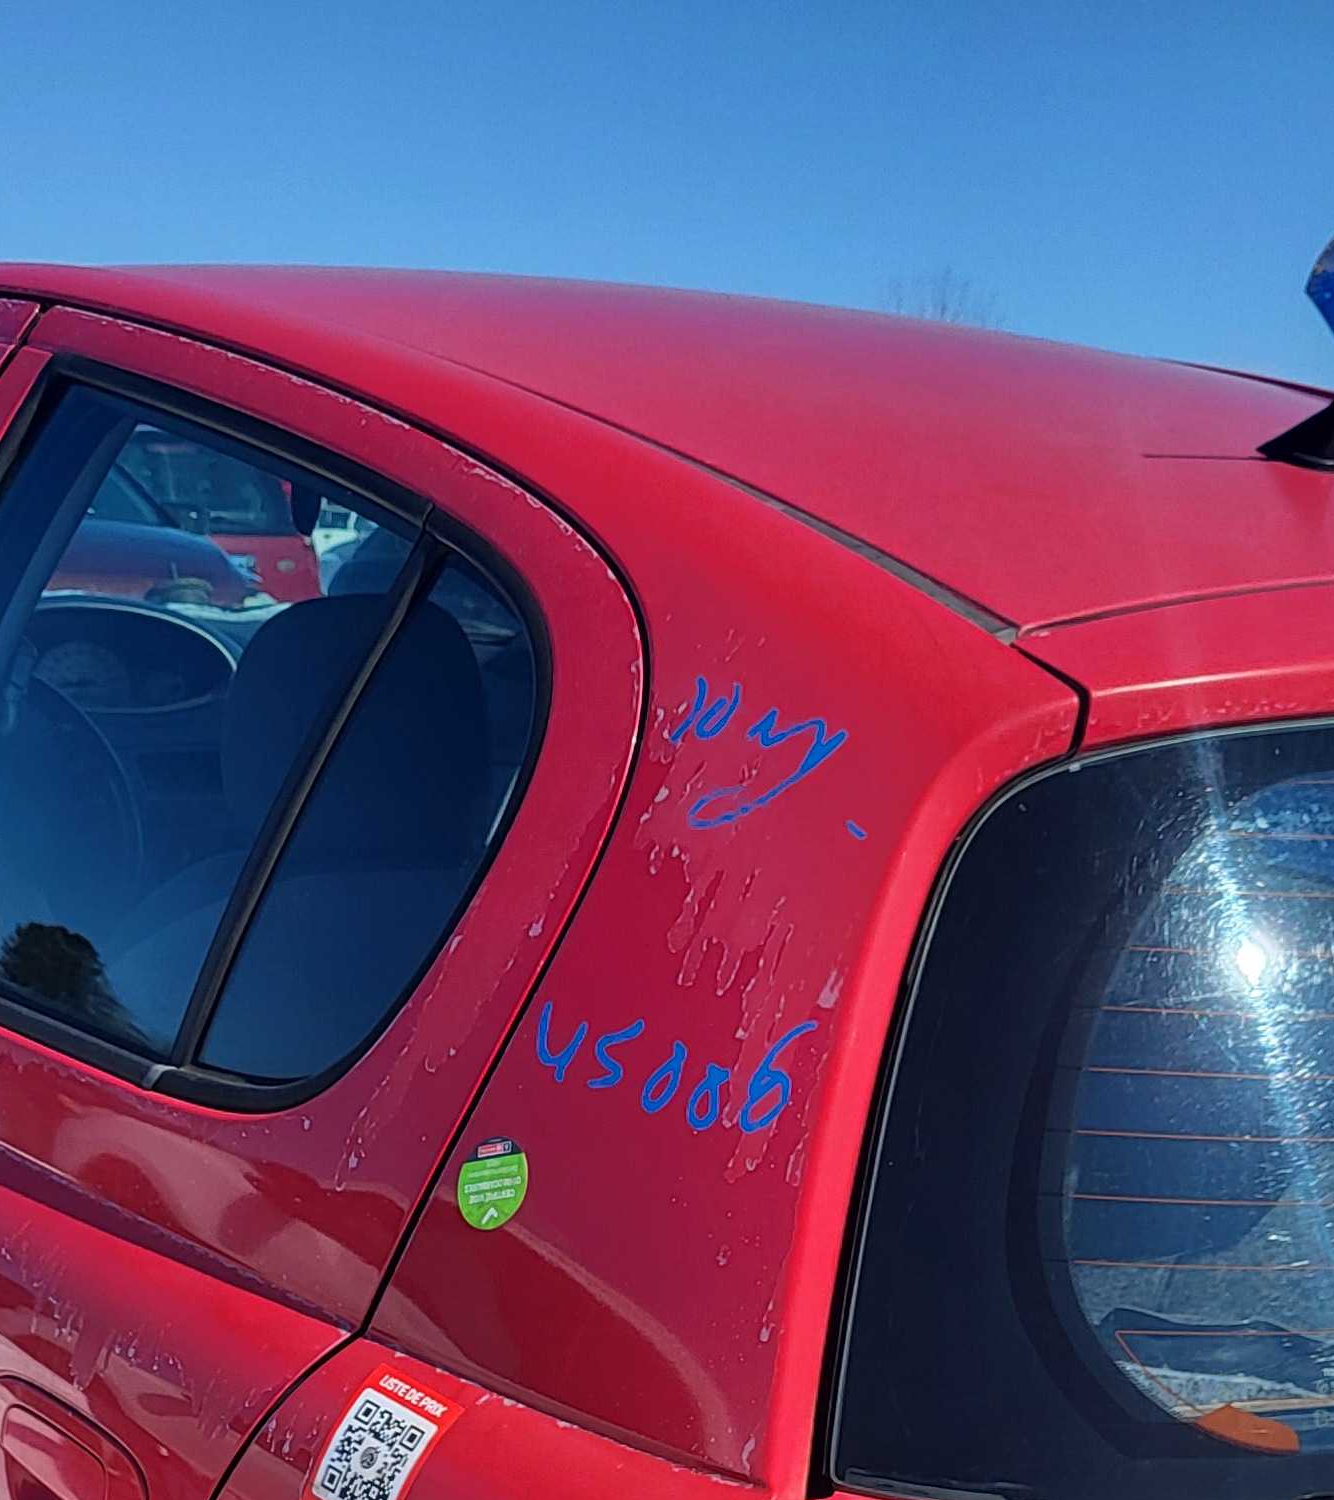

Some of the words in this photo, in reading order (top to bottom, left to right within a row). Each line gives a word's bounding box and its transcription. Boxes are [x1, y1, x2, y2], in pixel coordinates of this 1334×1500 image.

[378, 1374, 412, 1398] LISTE
[404, 1387, 425, 1406] DE
[417, 1396, 449, 1418] PRIX
